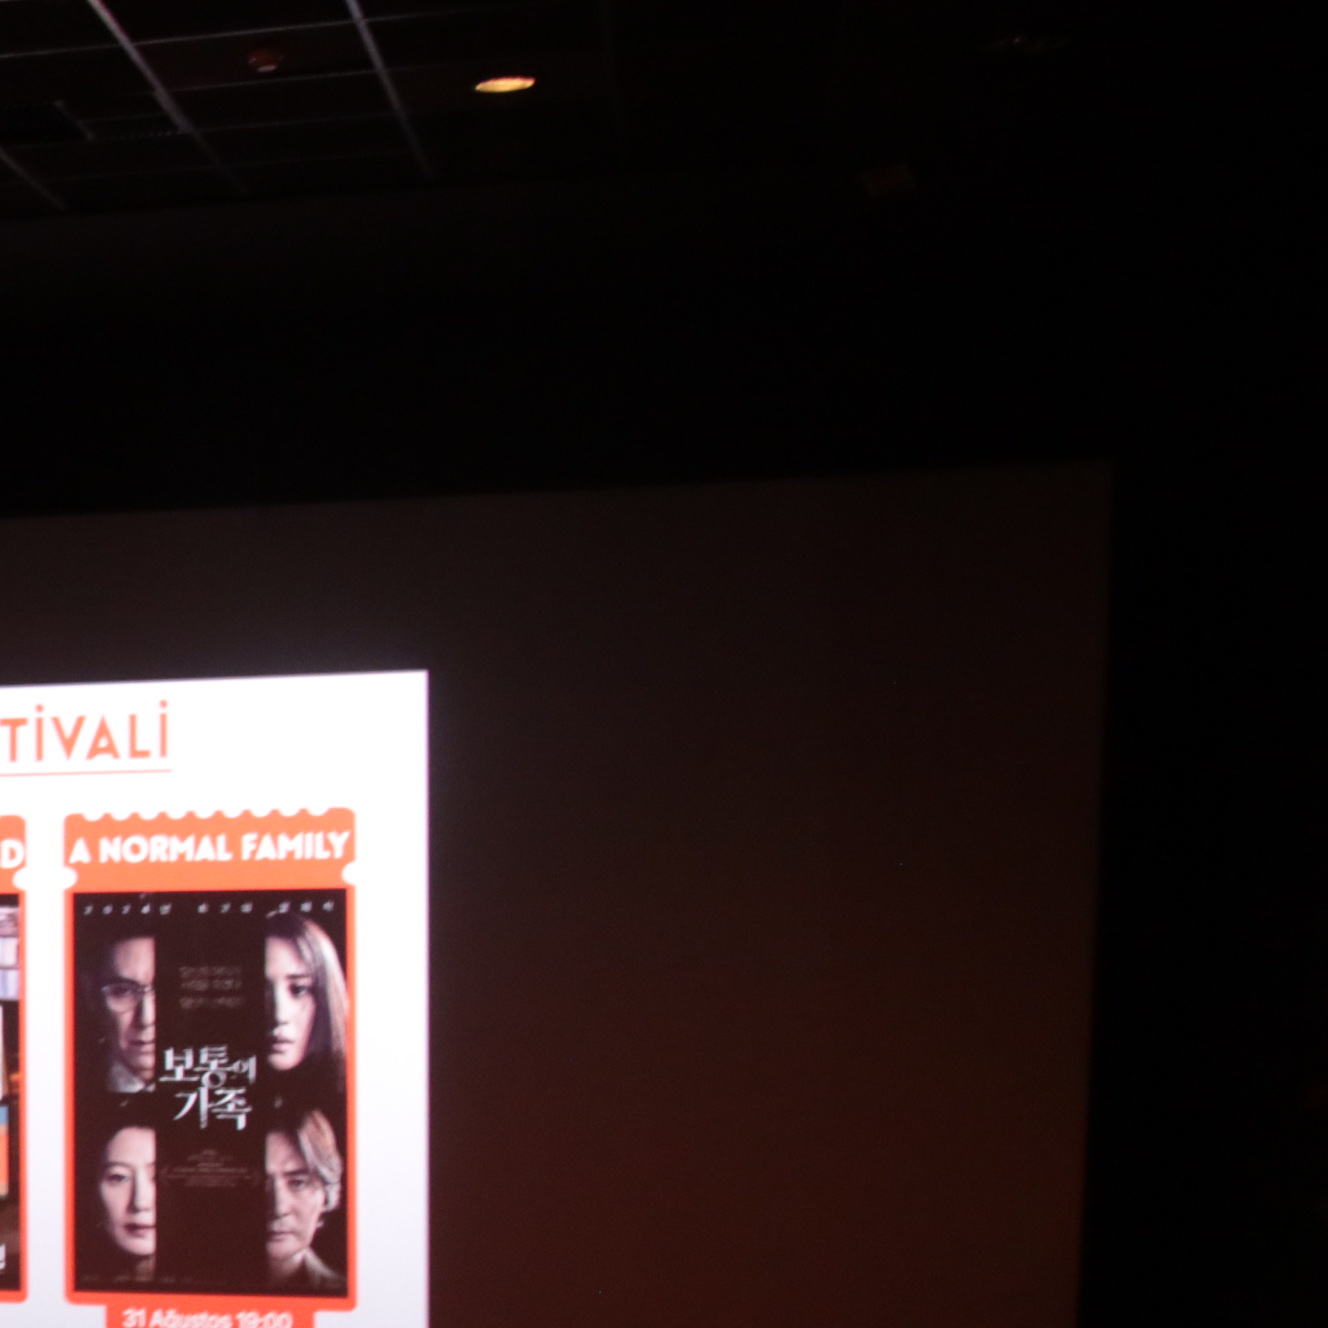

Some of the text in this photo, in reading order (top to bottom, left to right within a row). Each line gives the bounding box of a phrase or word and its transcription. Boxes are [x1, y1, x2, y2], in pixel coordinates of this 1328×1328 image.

[68, 831, 351, 863] A NORMAL FAMILY
[158, 1045, 258, 1089] 보통의
[173, 1086, 253, 1131] 가족
[122, 1308, 147, 1328] 31
